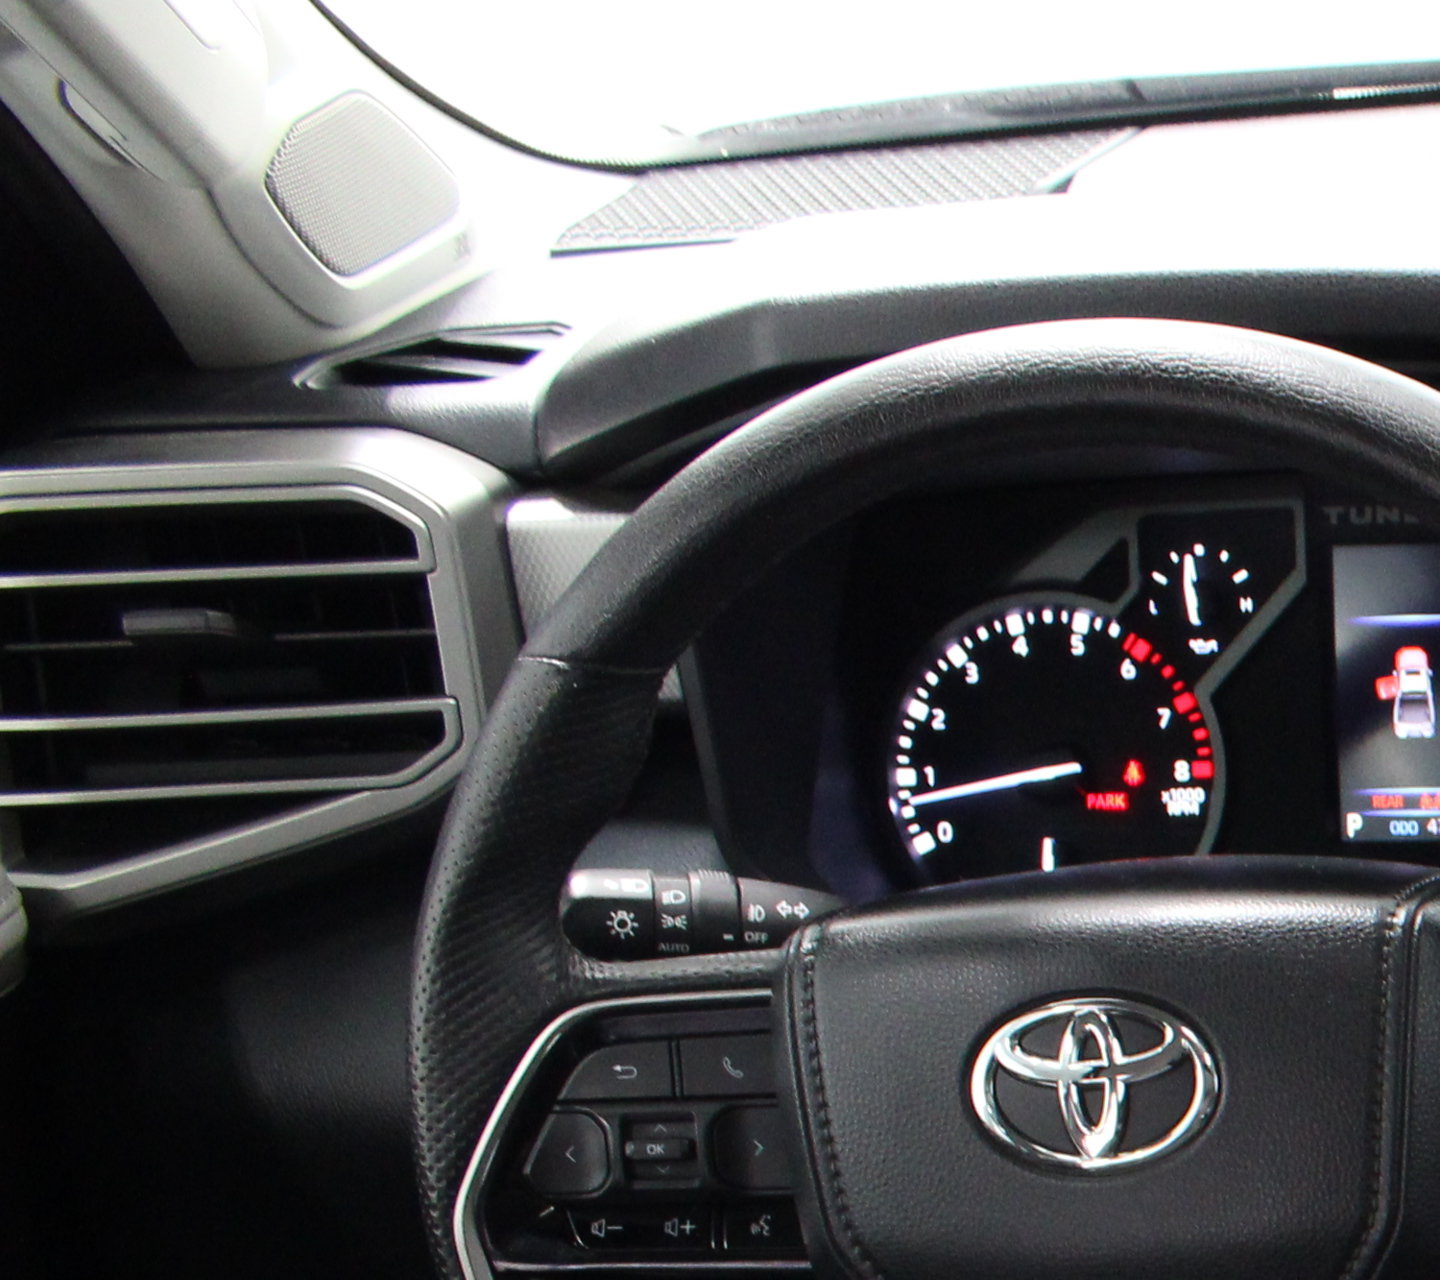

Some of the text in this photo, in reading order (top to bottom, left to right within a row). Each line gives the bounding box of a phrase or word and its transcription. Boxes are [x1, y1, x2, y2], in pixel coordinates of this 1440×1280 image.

[1012, 636, 1029, 658] 4
[1070, 635, 1085, 657] 5
[965, 662, 979, 684] 3
[1120, 658, 1136, 680] 6
[931, 709, 946, 731] 2
[1157, 707, 1171, 730] 7
[923, 765, 935, 786] 1
[1174, 760, 1191, 782] 8
[1087, 793, 1127, 810] PARK
[1371, 795, 1404, 809] REAR
[937, 822, 953, 843] 0
[1346, 812, 1363, 838] P
[1389, 819, 1419, 836] ODO
[657, 943, 690, 953] AUTO
[744, 931, 768, 944] OFF
[646, 1143, 665, 1155] OK
